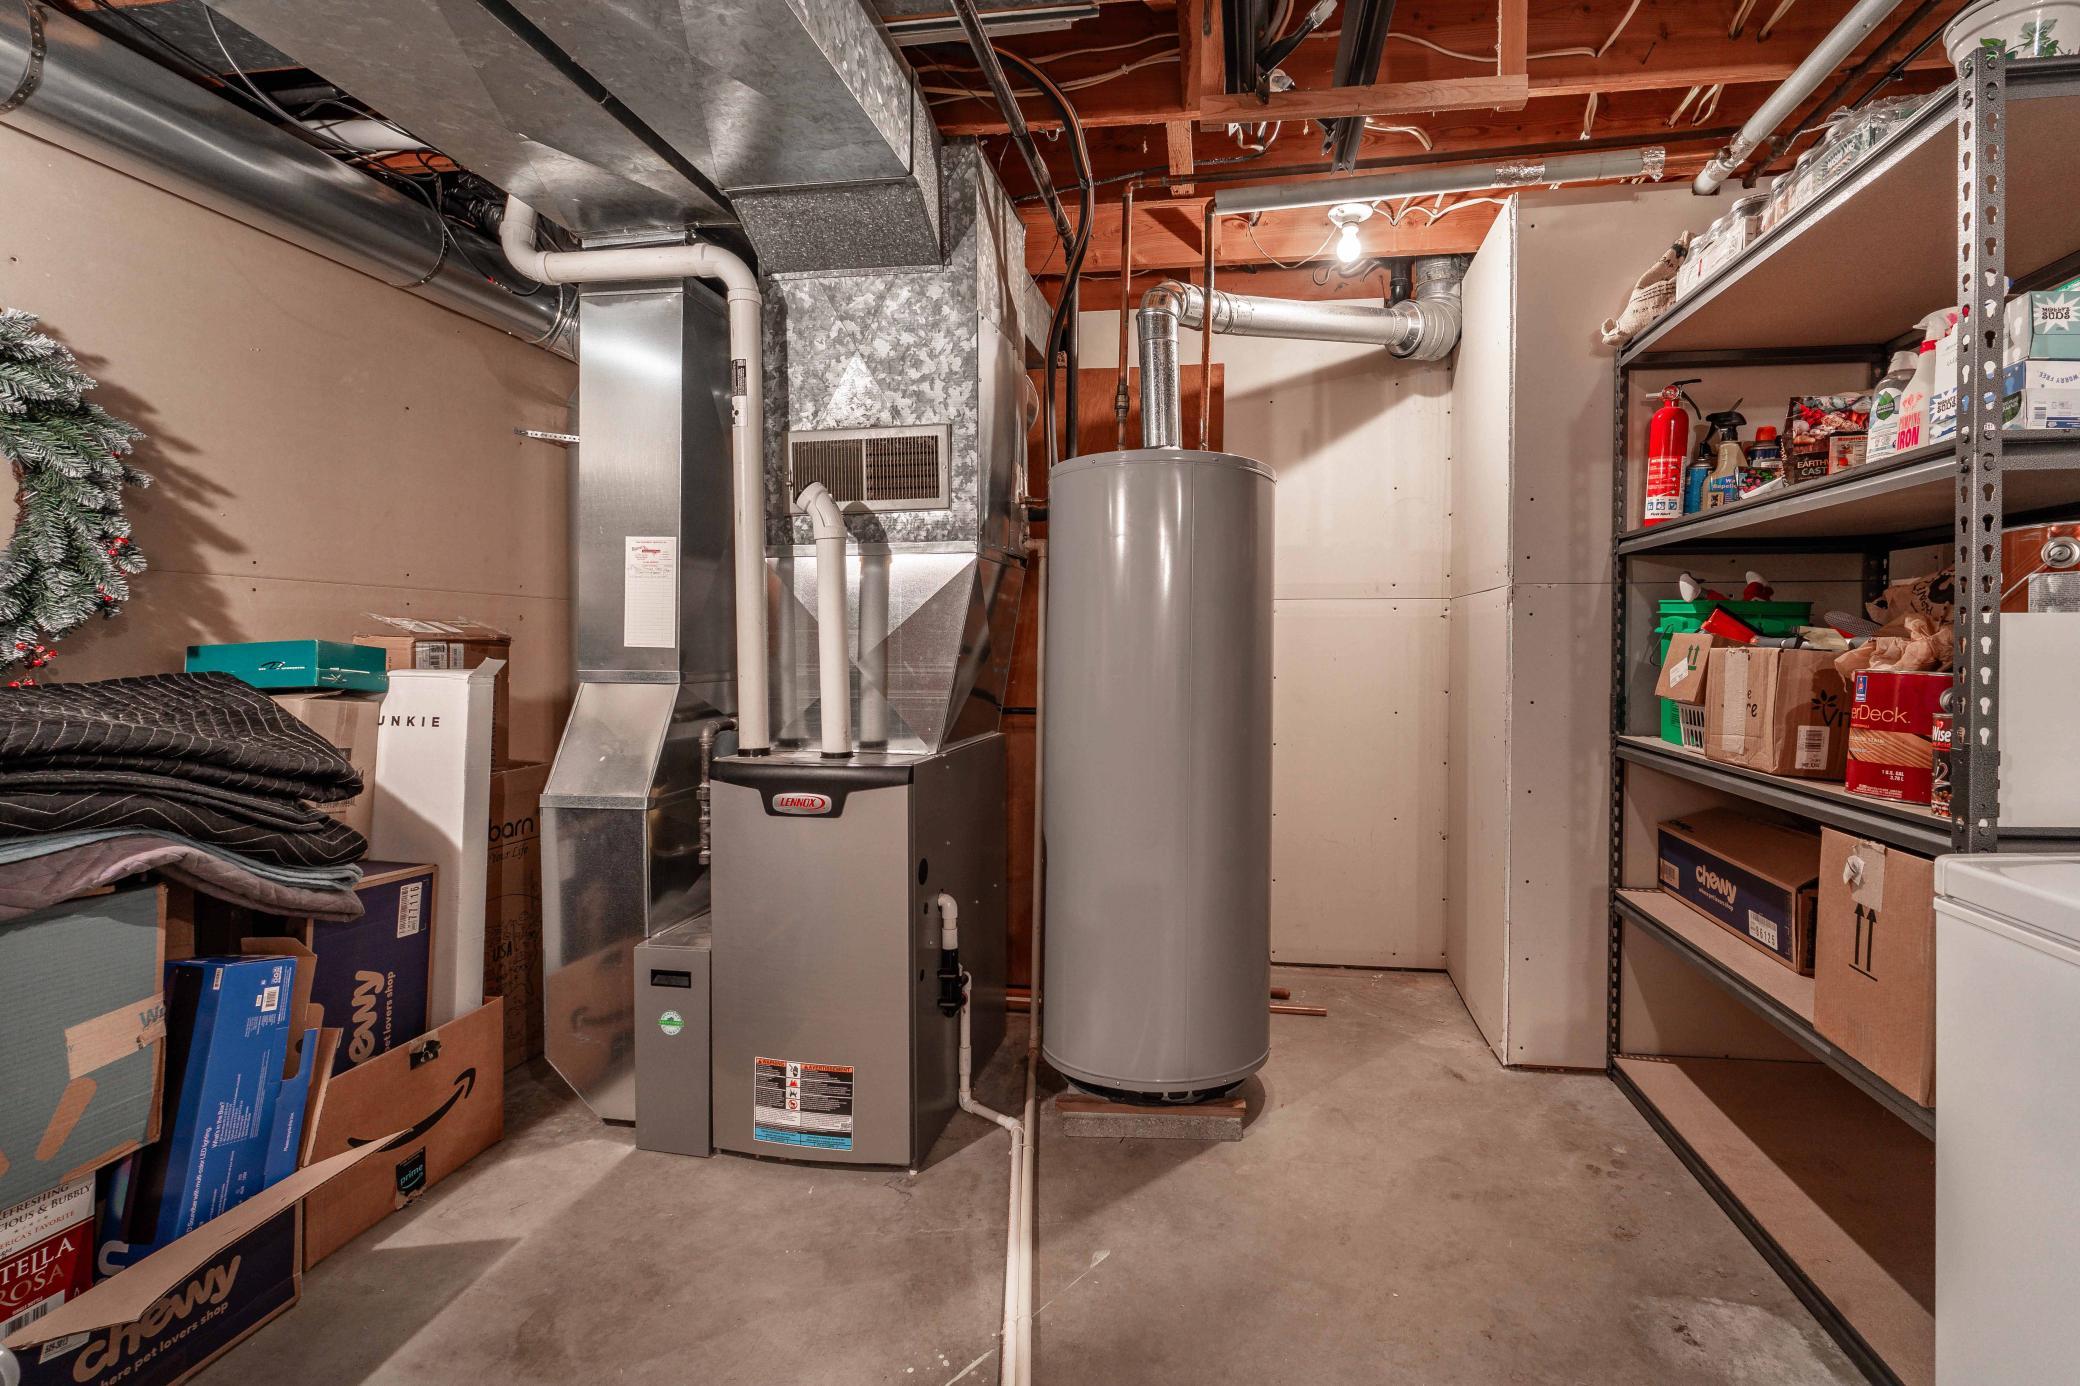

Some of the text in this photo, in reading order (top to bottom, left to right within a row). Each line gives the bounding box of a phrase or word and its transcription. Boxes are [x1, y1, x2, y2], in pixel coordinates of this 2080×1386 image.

[2042, 311, 2071, 320] SUDS
[2039, 371, 2079, 384] WORRY FREE
[1897, 426, 1920, 450] IRON
[1851, 705, 1911, 723] erDeck.
[780, 797, 816, 808] LENNOX
[1695, 865, 1737, 904] chewy
[384, 971, 396, 998] shop
[349, 970, 385, 1063] ewy
[384, 1000, 392, 1033] lovers
[400, 1164, 424, 1186] prime
[0, 1184, 69, 1220] EFRESHING
[38, 1204, 48, 1215] &
[51, 1183, 92, 1210] BUBBLY
[0, 1210, 75, 1250] ERICA'S FAVORITE
[0, 1237, 75, 1286] TELLA
[73, 1255, 241, 1384] chewy
[160, 1322, 198, 1353] lovers
[200, 1302, 229, 1327] shop
